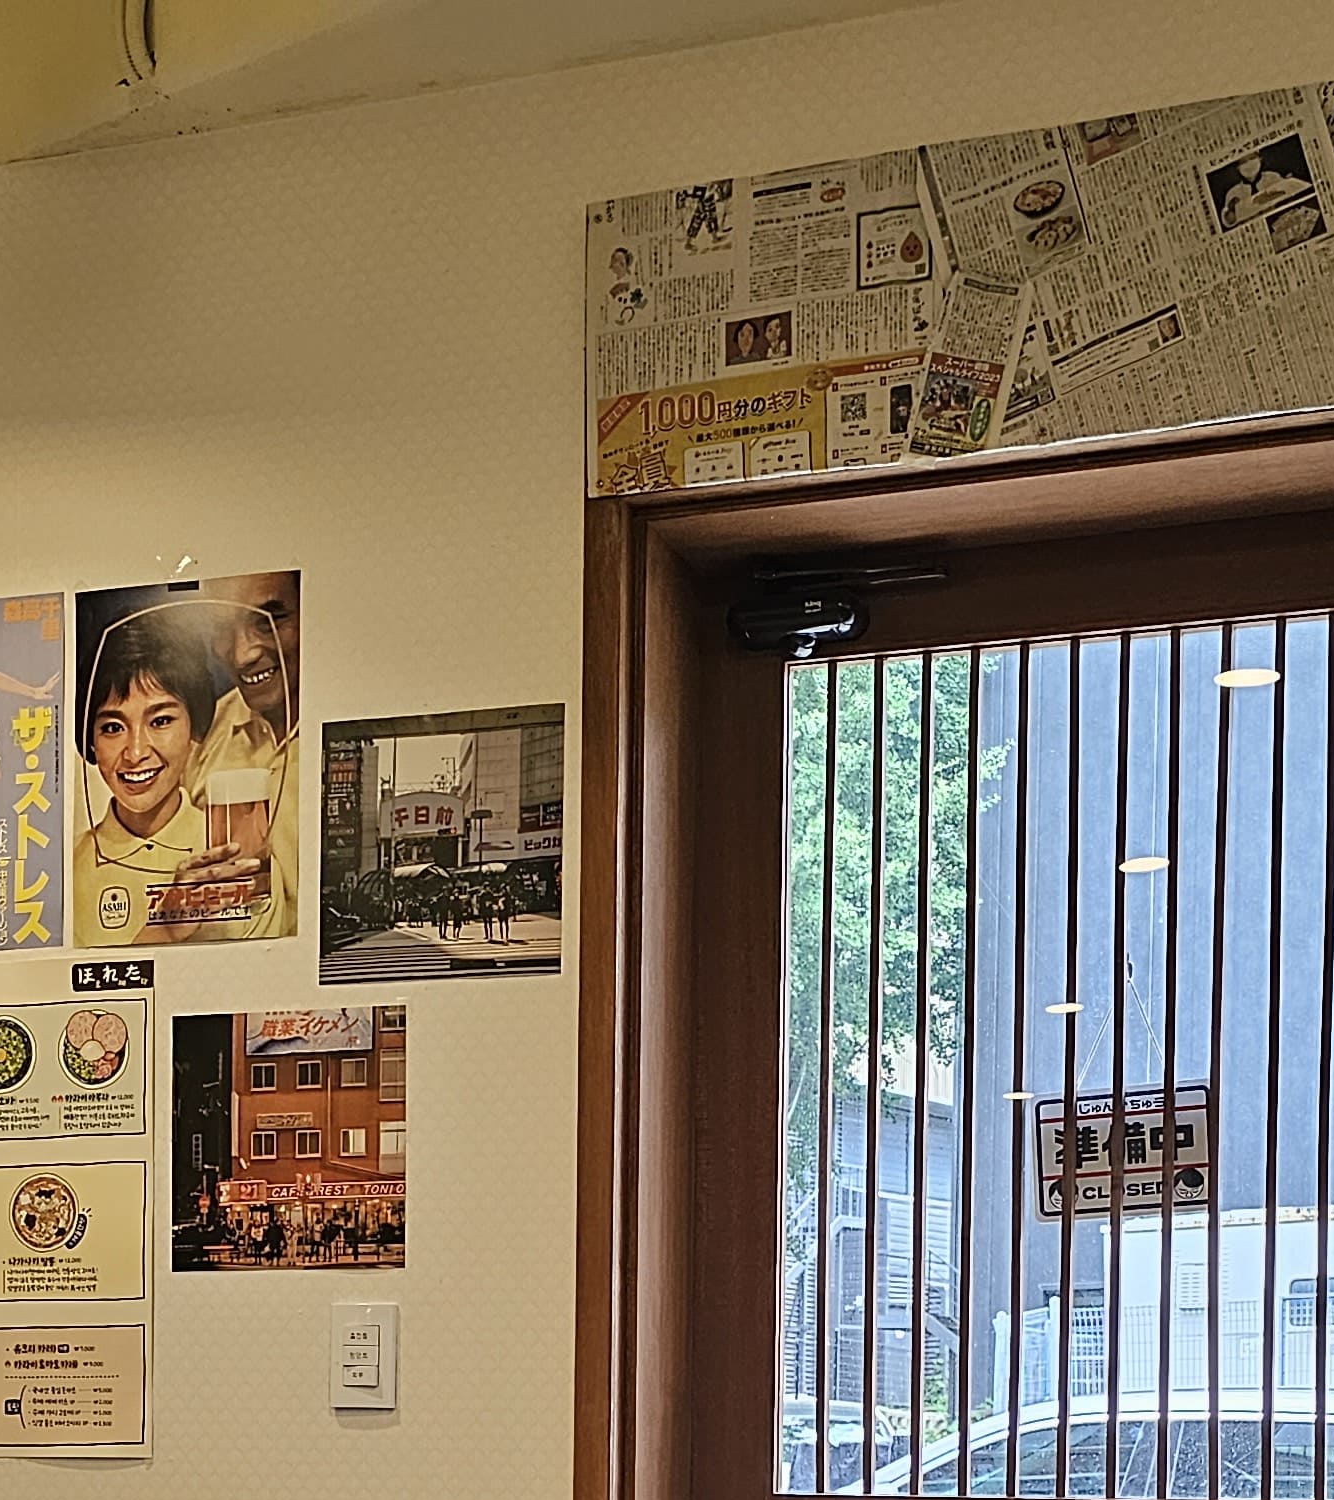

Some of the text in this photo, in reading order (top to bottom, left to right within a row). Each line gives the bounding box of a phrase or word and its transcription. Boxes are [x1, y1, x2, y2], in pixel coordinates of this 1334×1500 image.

[11, 706, 53, 944] ザ・ストレス
[395, 805, 454, 828] 千日前
[102, 902, 127, 913] ASAHI
[78, 965, 141, 984] ほれた
[1079, 1097, 1165, 1114] じゅんちゅう
[1082, 1181, 1167, 1200] CLSE
